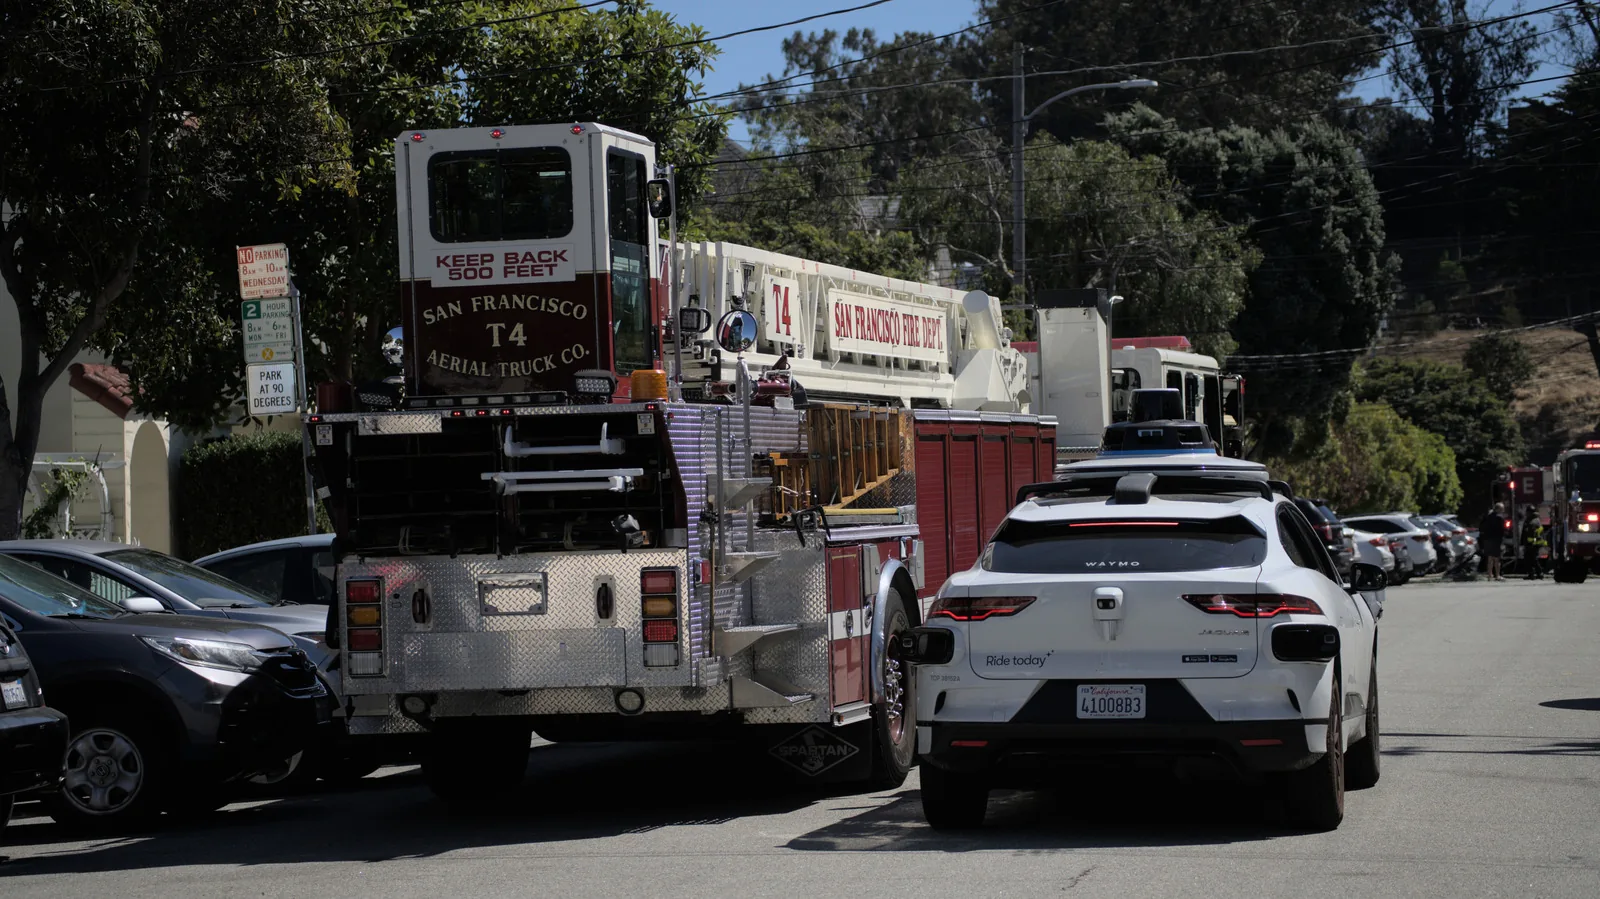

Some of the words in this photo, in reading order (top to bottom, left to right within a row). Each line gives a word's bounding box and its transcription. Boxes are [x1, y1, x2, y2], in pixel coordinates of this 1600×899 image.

[240, 250, 252, 263] NO
[255, 249, 284, 260] PARKING
[436, 253, 494, 268] KEEP
[504, 250, 568, 264] BACK
[448, 267, 493, 280] 500
[503, 264, 558, 278] FEET
[243, 276, 285, 288] WEDNESDAY
[246, 303, 257, 317] 2
[263, 310, 289, 318] PARKING
[422, 300, 463, 325] SAN
[471, 294, 588, 320] FRANCISCO
[773, 284, 791, 336] T4
[834, 301, 853, 338] SAN
[855, 304, 900, 346] FRANCISCO
[902, 312, 921, 348] FIRE
[922, 316, 943, 350] DEPT.
[486, 322, 527, 347] T4
[426, 350, 491, 377] AERIAL
[498, 354, 556, 377] TRUCK
[561, 343, 590, 364] CO.
[260, 371, 282, 381] PARK
[260, 384, 269, 394] AT
[273, 384, 283, 393] 90
[254, 396, 291, 408] DEGREES
[1523, 477, 1534, 494] E
[986, 655, 1010, 666] Ride
[1013, 656, 1046, 668] today
[1091, 687, 1132, 697] California
[1081, 697, 1141, 713] 41008B3
[779, 745, 847, 756] SPARTAN
